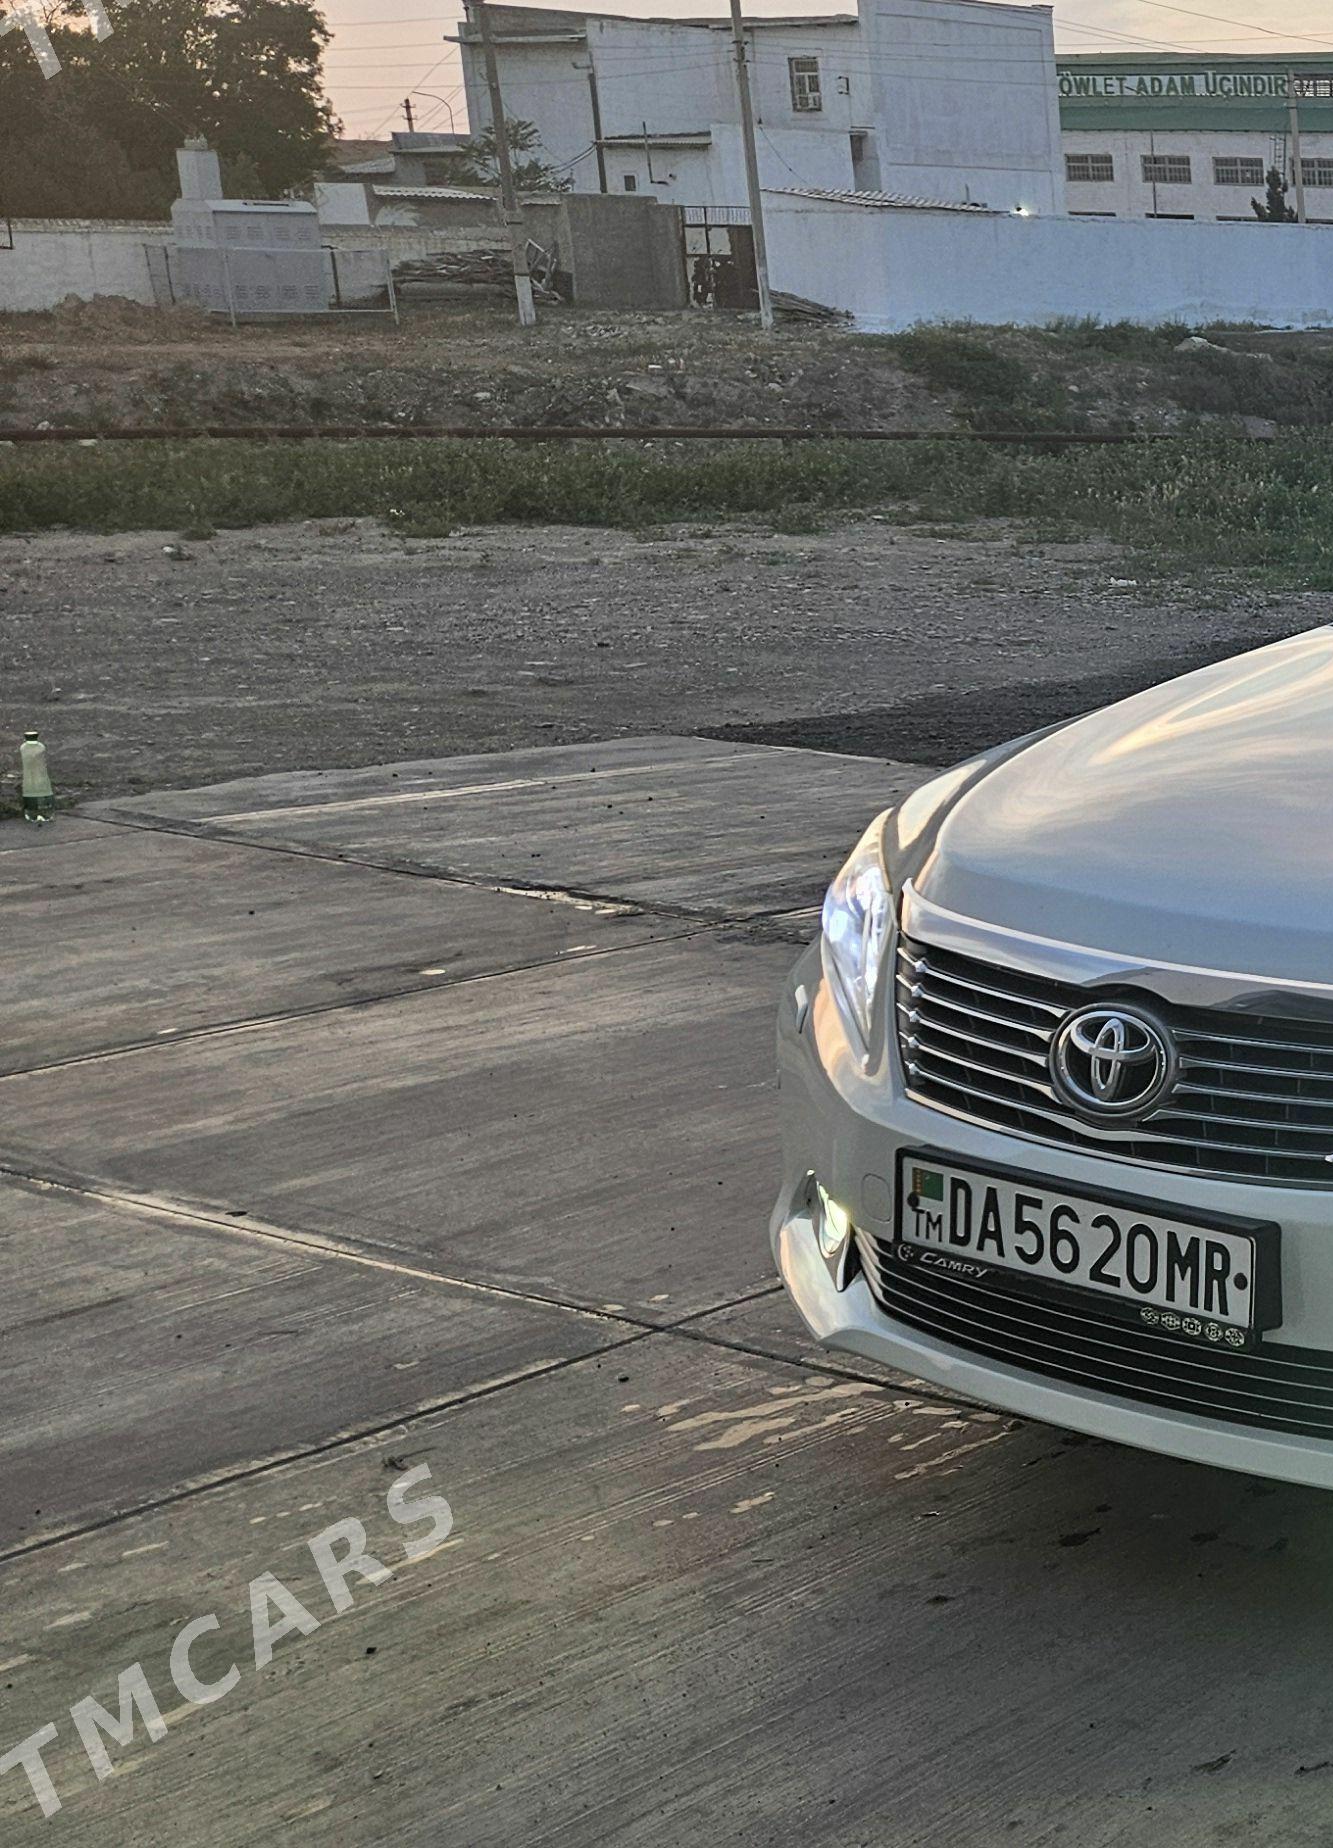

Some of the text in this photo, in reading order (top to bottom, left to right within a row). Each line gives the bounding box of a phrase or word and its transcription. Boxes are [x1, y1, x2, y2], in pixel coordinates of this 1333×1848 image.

[1058, 72, 1127, 95] ÖWLET
[1136, 76, 1195, 95] ADAM
[911, 1176, 1230, 1316] TM DA5620MR
[920, 1252, 988, 1278] CAMRY
